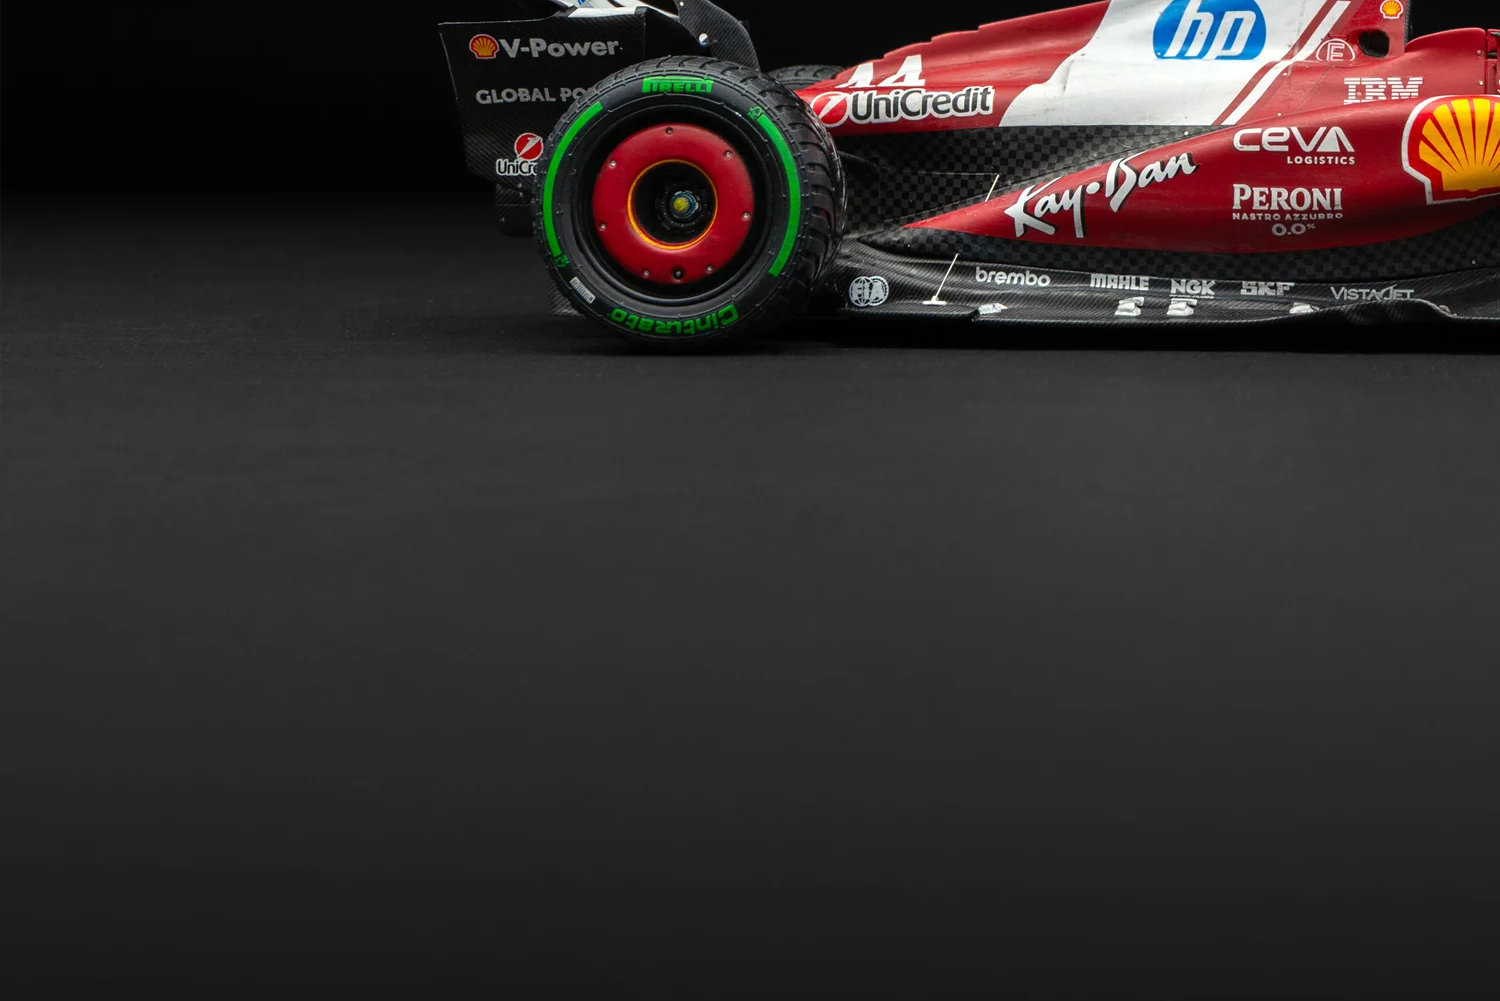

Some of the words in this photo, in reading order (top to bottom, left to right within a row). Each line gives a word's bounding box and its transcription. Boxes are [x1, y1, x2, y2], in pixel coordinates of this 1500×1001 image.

[499, 37, 619, 58] V-Power
[641, 76, 714, 94] PIRELLI
[1343, 77, 1423, 105] IBM
[475, 87, 556, 105] GLOBAL
[851, 86, 992, 121] UniCredit
[1287, 156, 1356, 165] LOGISTICS
[1232, 183, 1343, 211] PERONI
[1232, 212, 1281, 221] NASTRO
[1284, 212, 1343, 221] AZZURRO
[1271, 222, 1316, 237] 0.0%
[975, 267, 1050, 287] brembo
[1089, 273, 1149, 291] MAHLE
[1171, 279, 1216, 295] NGK
[1240, 281, 1295, 296] SKF
[610, 304, 739, 335] Cinturato
